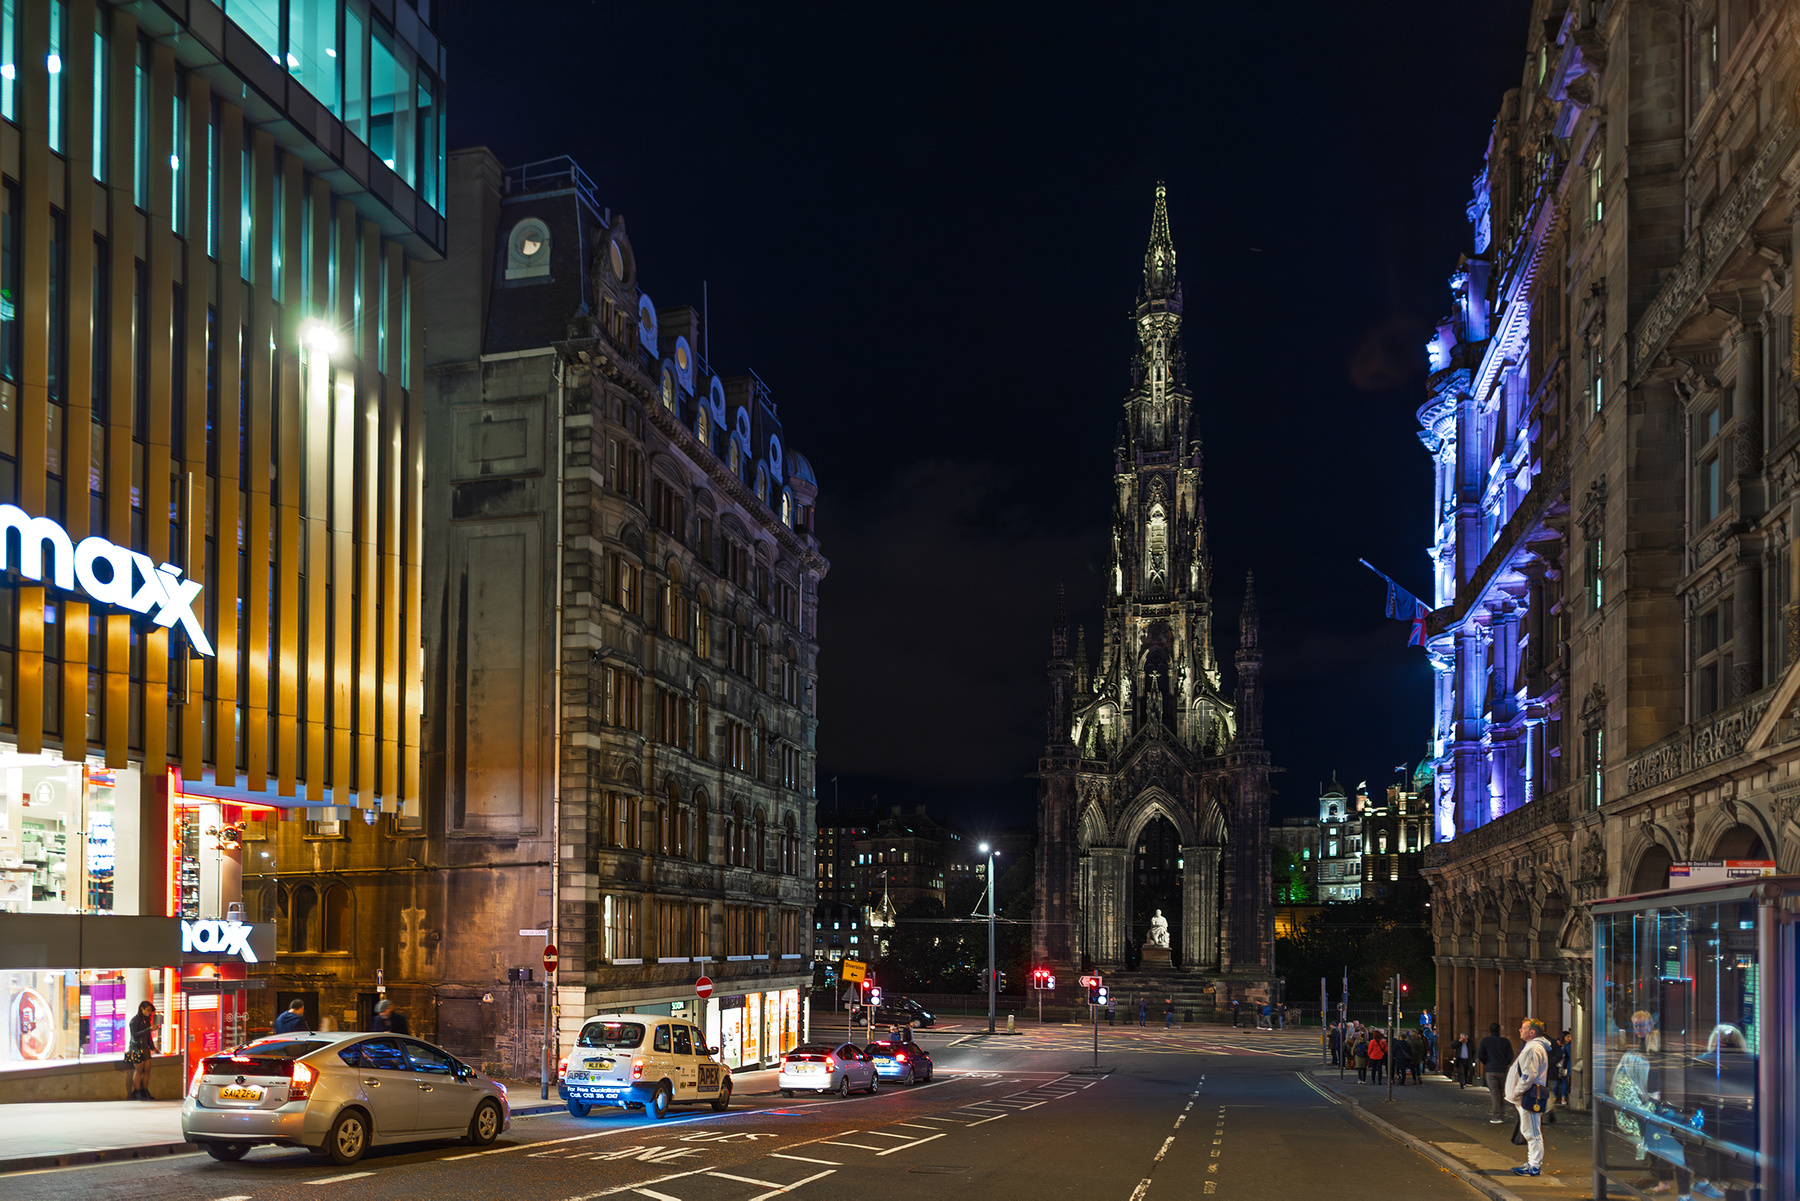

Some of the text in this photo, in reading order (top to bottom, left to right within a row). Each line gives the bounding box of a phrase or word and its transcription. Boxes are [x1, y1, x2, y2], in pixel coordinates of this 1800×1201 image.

[0, 503, 215, 657] maxx
[845, 962, 865, 970] Diversion
[568, 1071, 589, 1080] APEX
[699, 1067, 719, 1085] APEX
[223, 1088, 256, 1099] SA12 ZPG
